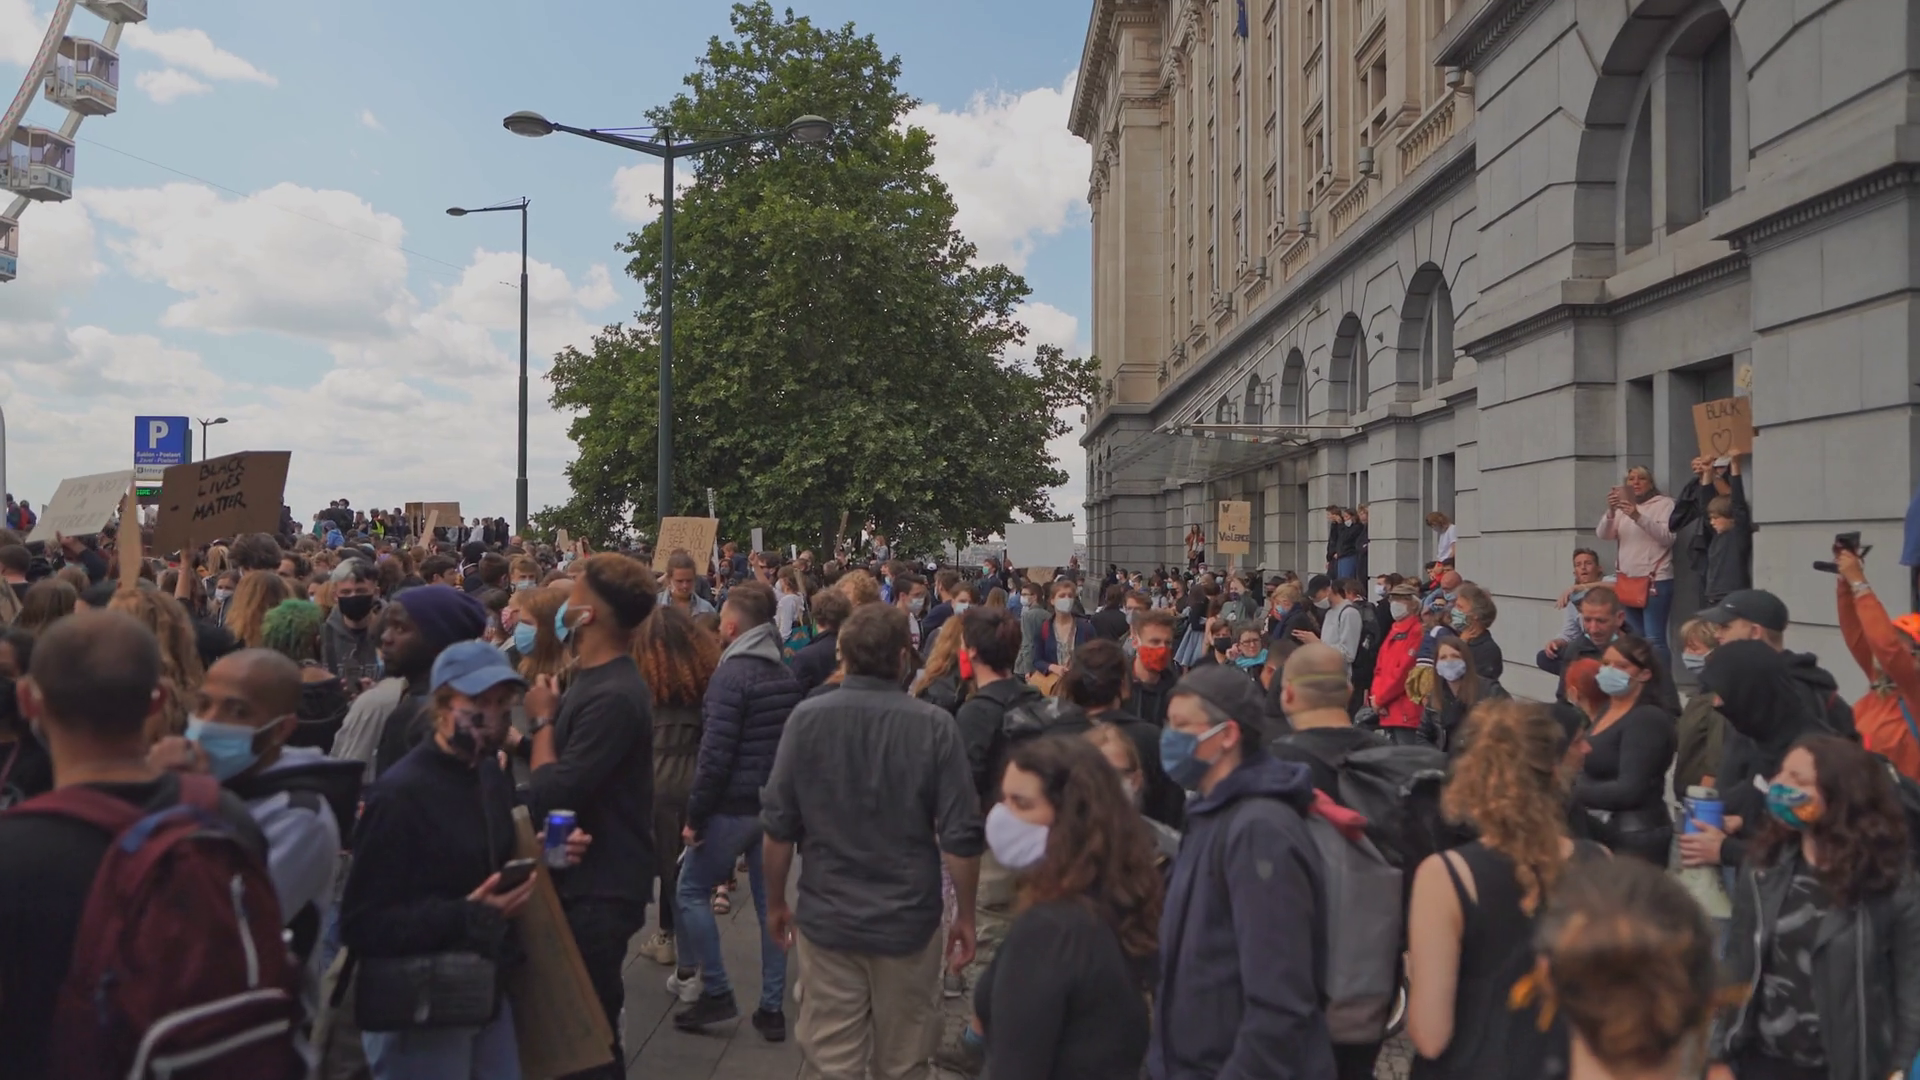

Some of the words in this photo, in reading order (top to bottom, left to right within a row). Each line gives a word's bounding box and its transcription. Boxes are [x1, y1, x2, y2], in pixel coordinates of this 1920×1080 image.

[1705, 400, 1742, 420] BLACK
[149, 421, 169, 449] P
[199, 457, 245, 481] BLACK
[198, 473, 244, 497] LIVES
[192, 492, 247, 521] MATTER
[666, 521, 687, 537] HEAR
[691, 523, 708, 538] YOU
[667, 536, 684, 549] SEE
[689, 537, 706, 550] YOU
